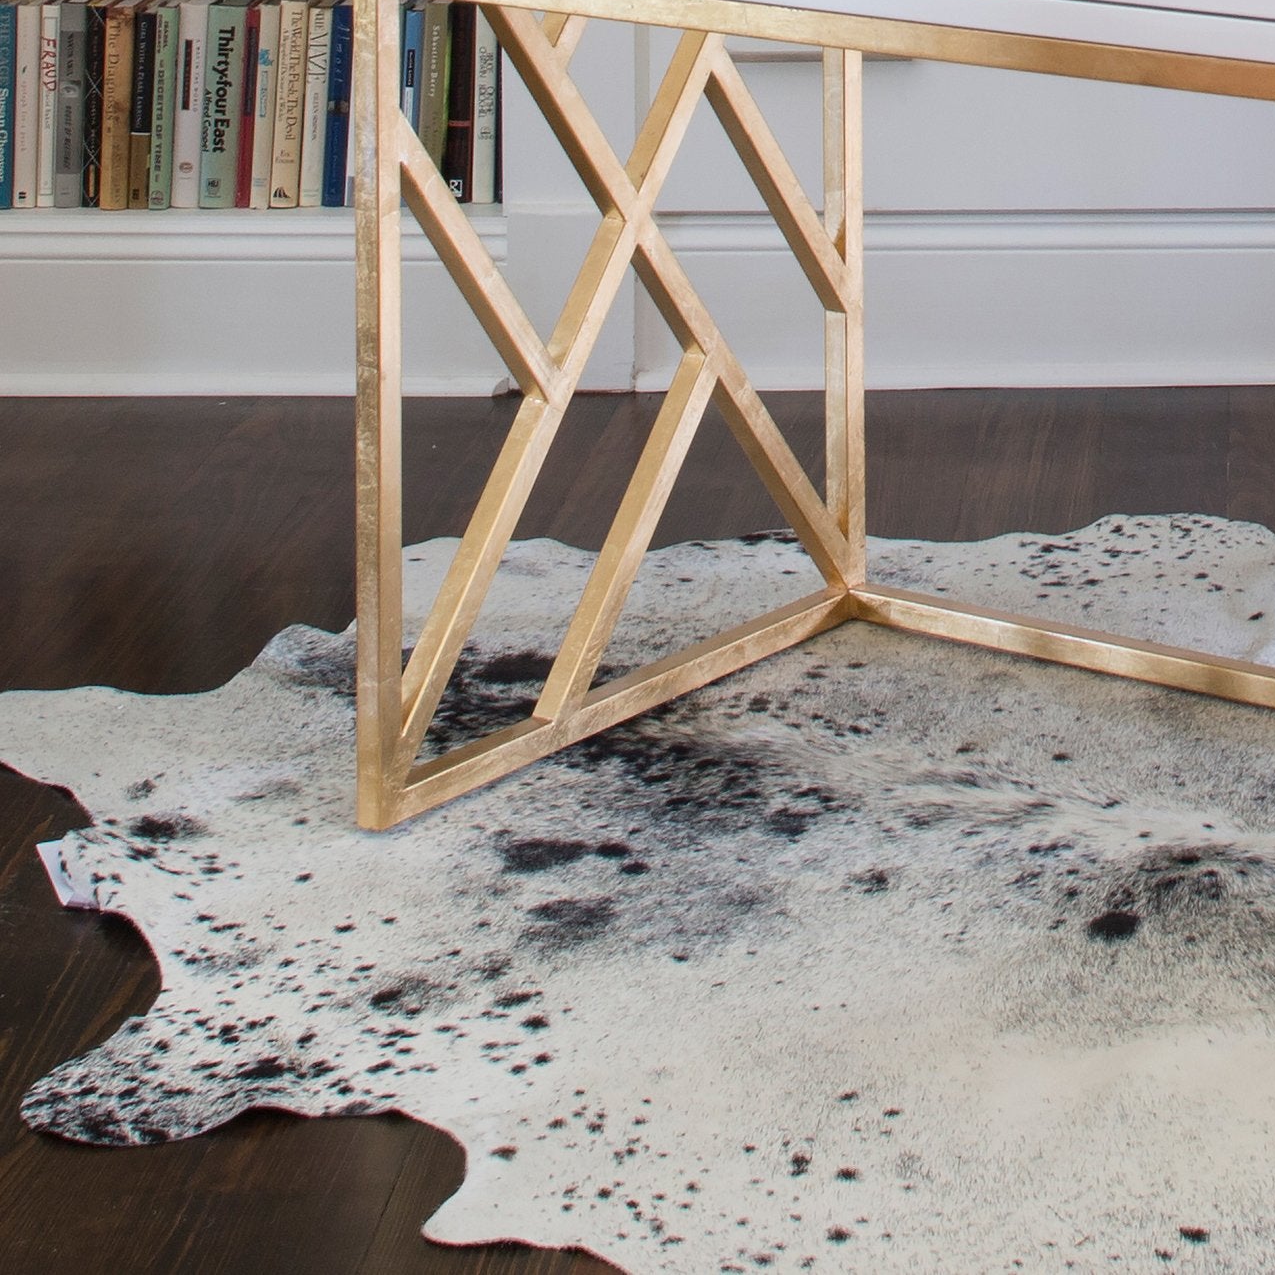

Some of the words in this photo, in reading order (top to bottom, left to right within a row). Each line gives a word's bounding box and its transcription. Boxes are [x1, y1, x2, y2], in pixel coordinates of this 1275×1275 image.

[108, 23, 122, 46] The
[430, 25, 440, 70] Sebastian
[40, 37, 57, 91] FRAUD
[106, 53, 120, 122] Diagnosis
[155, 69, 165, 120] DECEITS
[428, 72, 438, 98] Barry
[155, 124, 164, 140] OF
[212, 118, 230, 153] East
[154, 143, 163, 172] TIME
